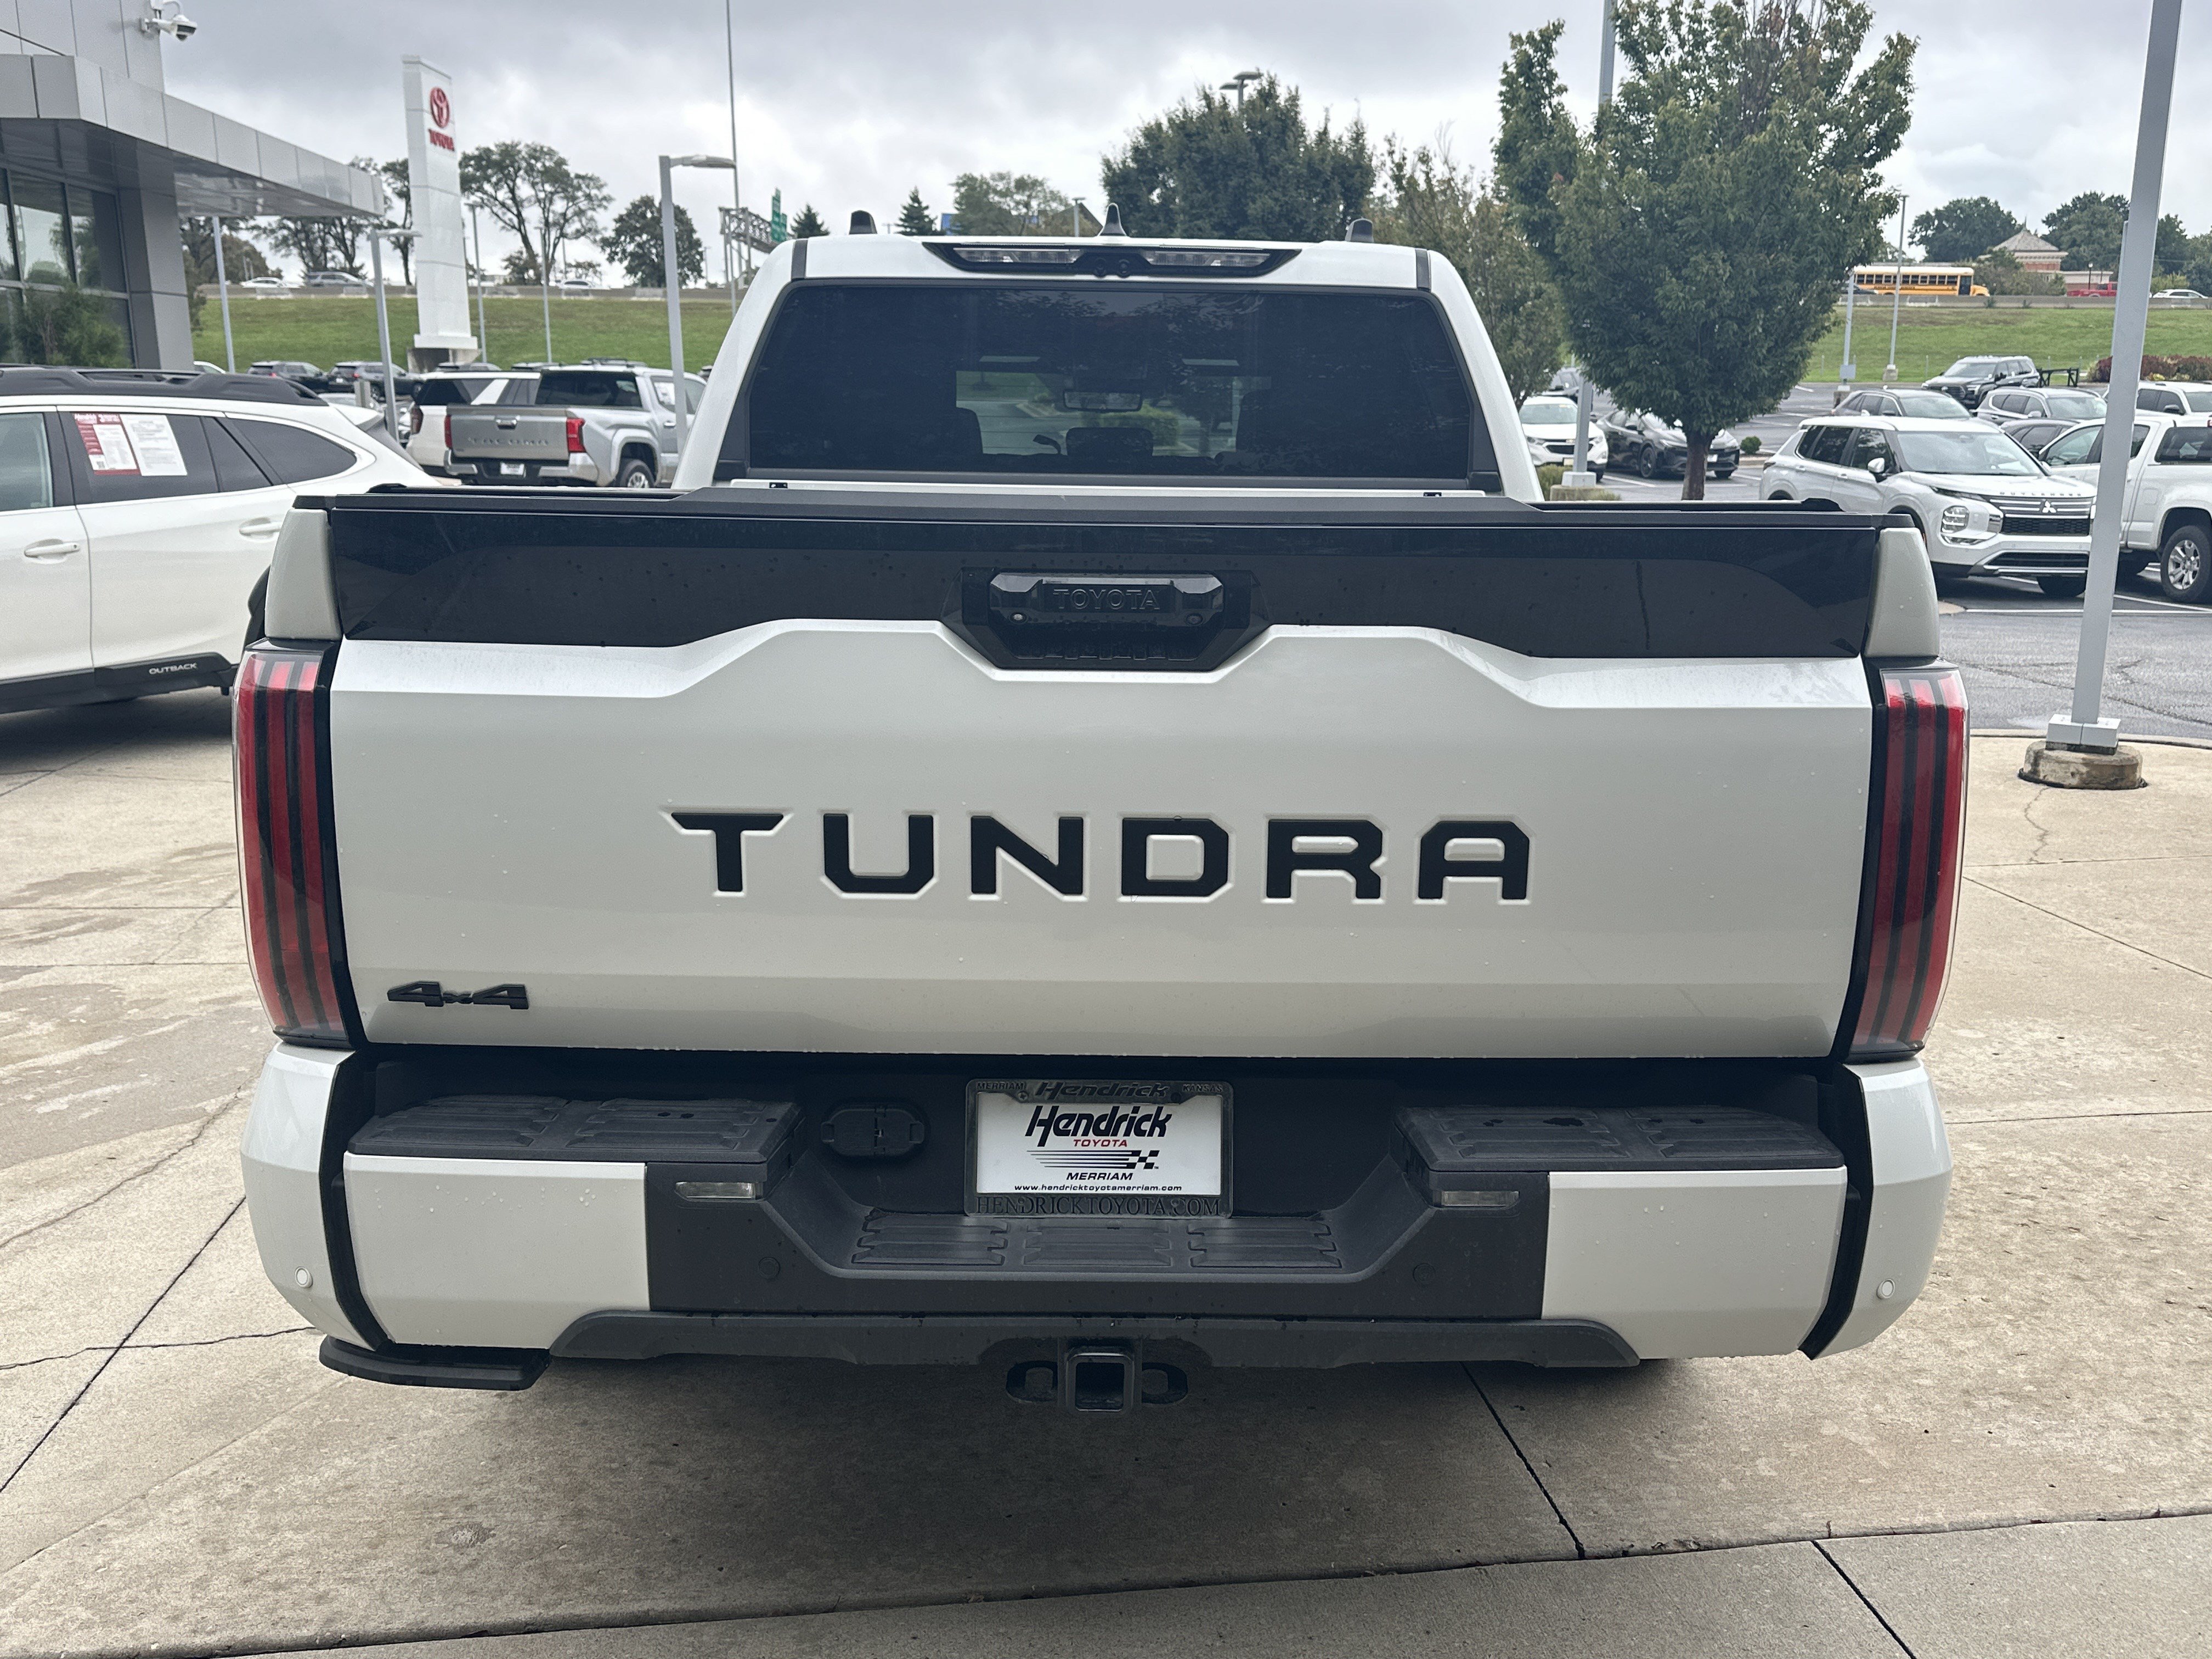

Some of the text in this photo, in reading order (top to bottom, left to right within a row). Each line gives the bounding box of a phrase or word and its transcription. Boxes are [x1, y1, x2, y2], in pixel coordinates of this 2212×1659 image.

[1052, 588, 1160, 611] TOYOTA
[149, 662, 198, 675] OUTBACK
[667, 810, 1533, 901] TUNDRA
[977, 1082, 1025, 1090] MERRIAM
[1035, 1081, 1170, 1100] Hendrick
[1182, 1084, 1223, 1092] KANSAS
[1025, 1105, 1172, 1147] Hendrick
[1073, 1139, 1128, 1147] TOYOTA
[1066, 1172, 1133, 1181] MERRIAM
[1014, 1183, 1182, 1192] www.hendricktoyotamerriam.com
[977, 1195, 1221, 1216] HENDRICKTOYOTA.COM
